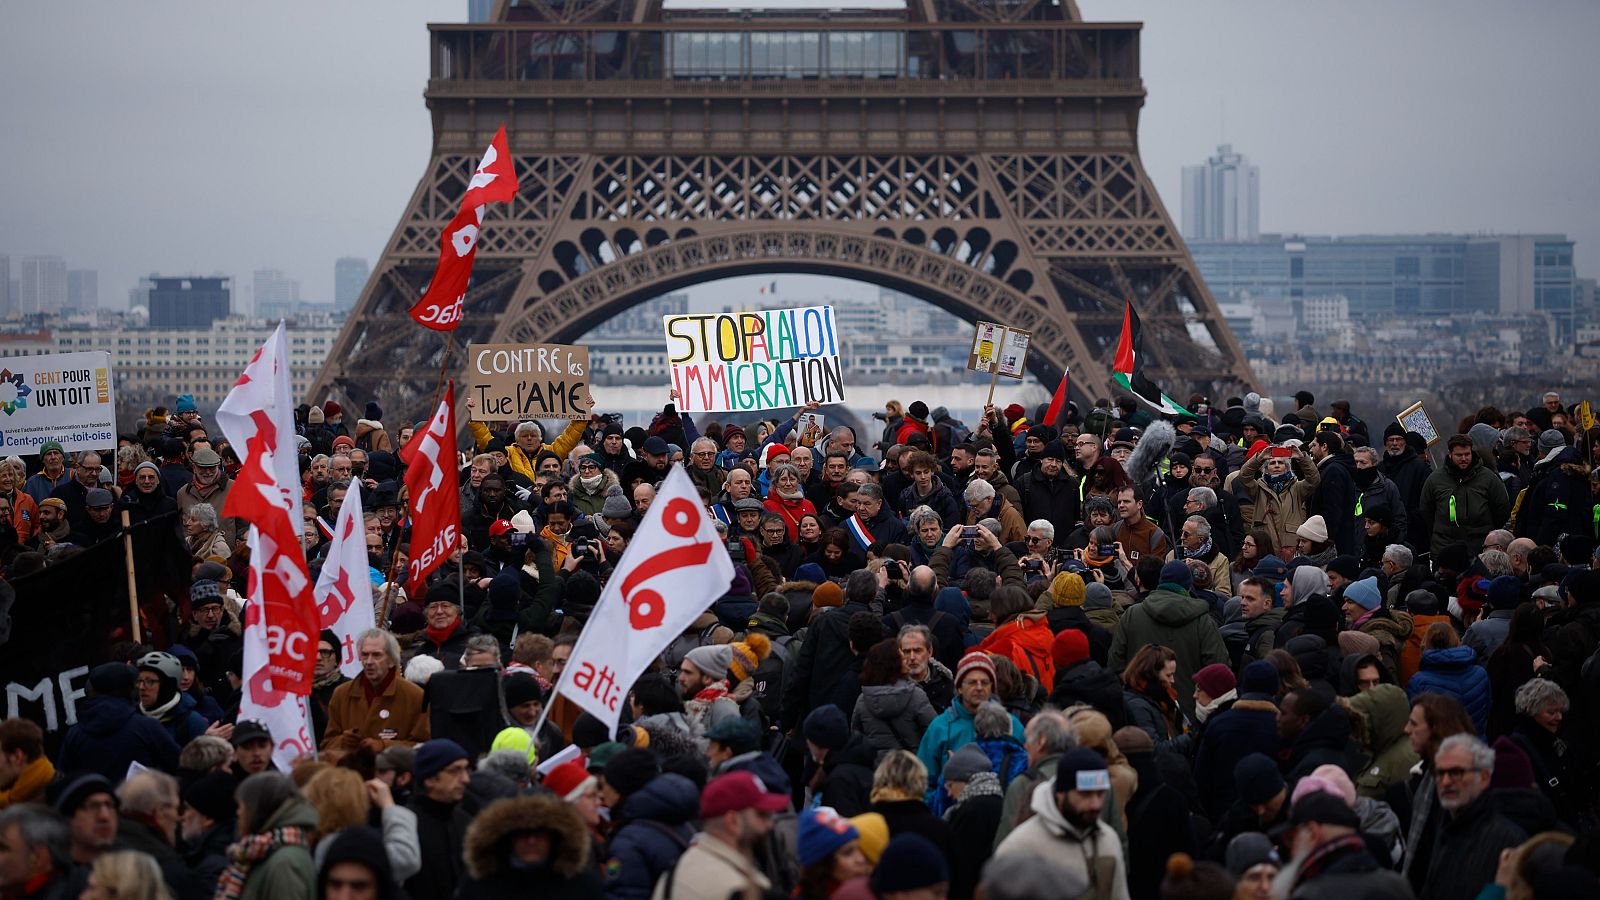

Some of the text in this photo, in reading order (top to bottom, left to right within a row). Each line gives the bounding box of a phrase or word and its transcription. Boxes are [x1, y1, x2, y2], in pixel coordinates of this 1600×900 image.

[668, 313, 766, 363] STOP
[765, 311, 795, 361] LA
[477, 347, 562, 375] CONTRE
[34, 369, 91, 385] CENT POUR
[97, 374, 109, 398] OISE
[35, 386, 92, 408] UN TOIT
[475, 384, 513, 415] Tue
